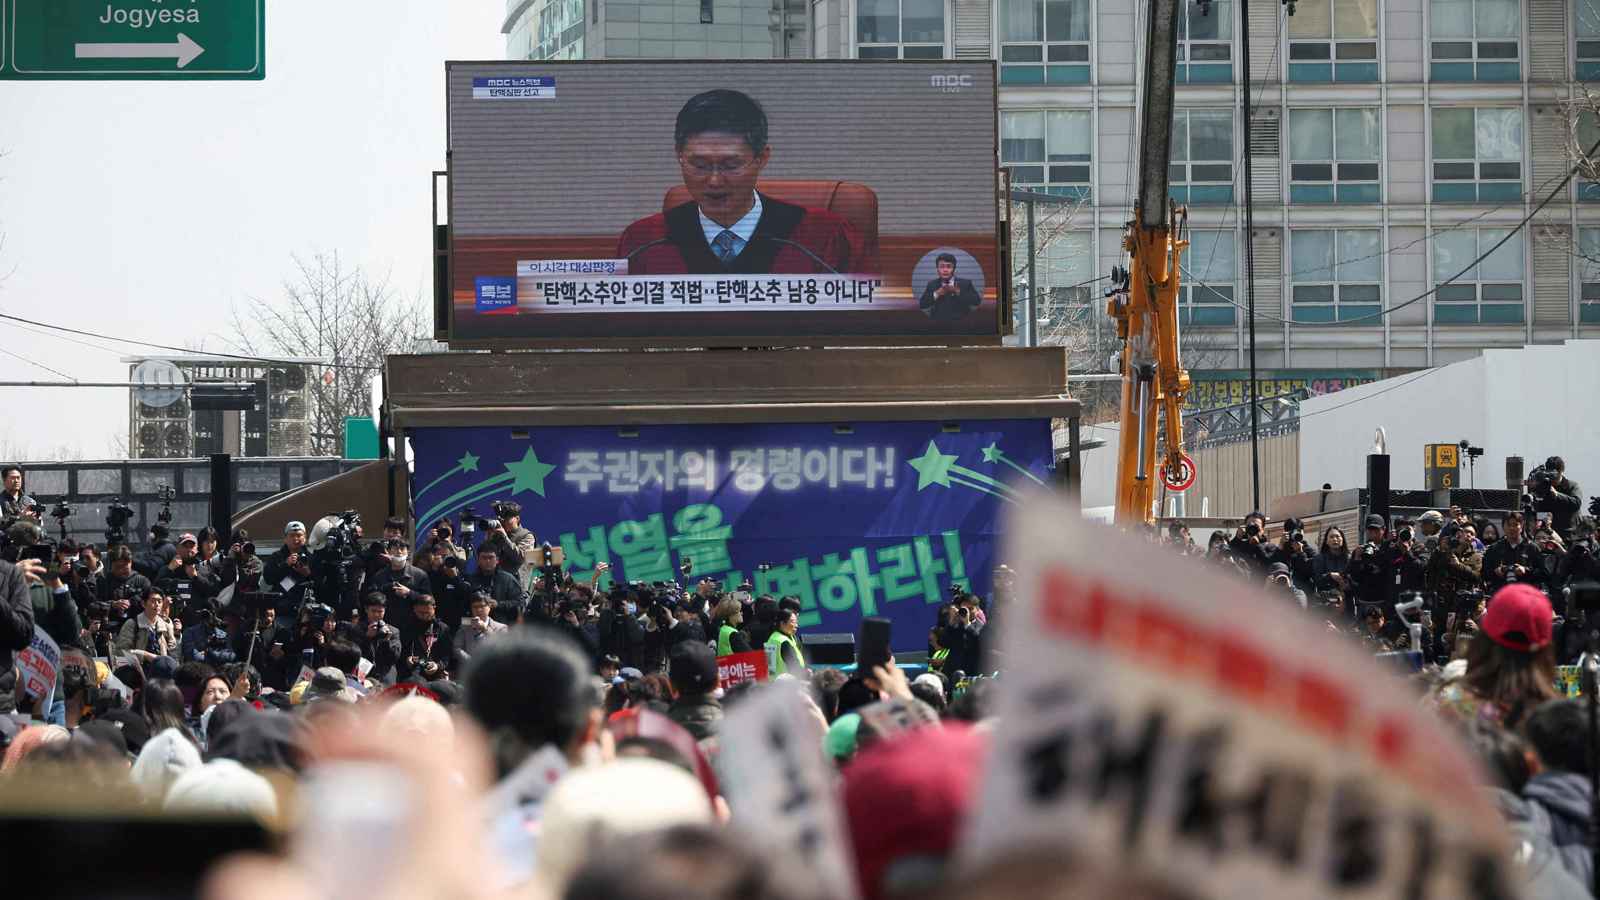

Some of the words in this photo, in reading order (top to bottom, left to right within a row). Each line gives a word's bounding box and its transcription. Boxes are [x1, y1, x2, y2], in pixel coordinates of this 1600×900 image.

[100, 4, 200, 28] Jogyesa
[931, 75, 972, 86] MBC
[530, 263, 541, 273] 이
[545, 262, 566, 273] 시각
[570, 261, 616, 273] 대심판정
[481, 285, 511, 299] 특보
[536, 280, 628, 305] "탄핵소추안
[632, 280, 665, 304] 의결
[787, 278, 820, 304] 남용
[824, 278, 881, 304] 아니다"
[564, 448, 715, 494] 주권자의
[730, 446, 896, 492] 명령이다!
[1442, 472, 1452, 489] 6
[528, 503, 734, 592] 석열을
[685, 529, 972, 628] 면하라!
